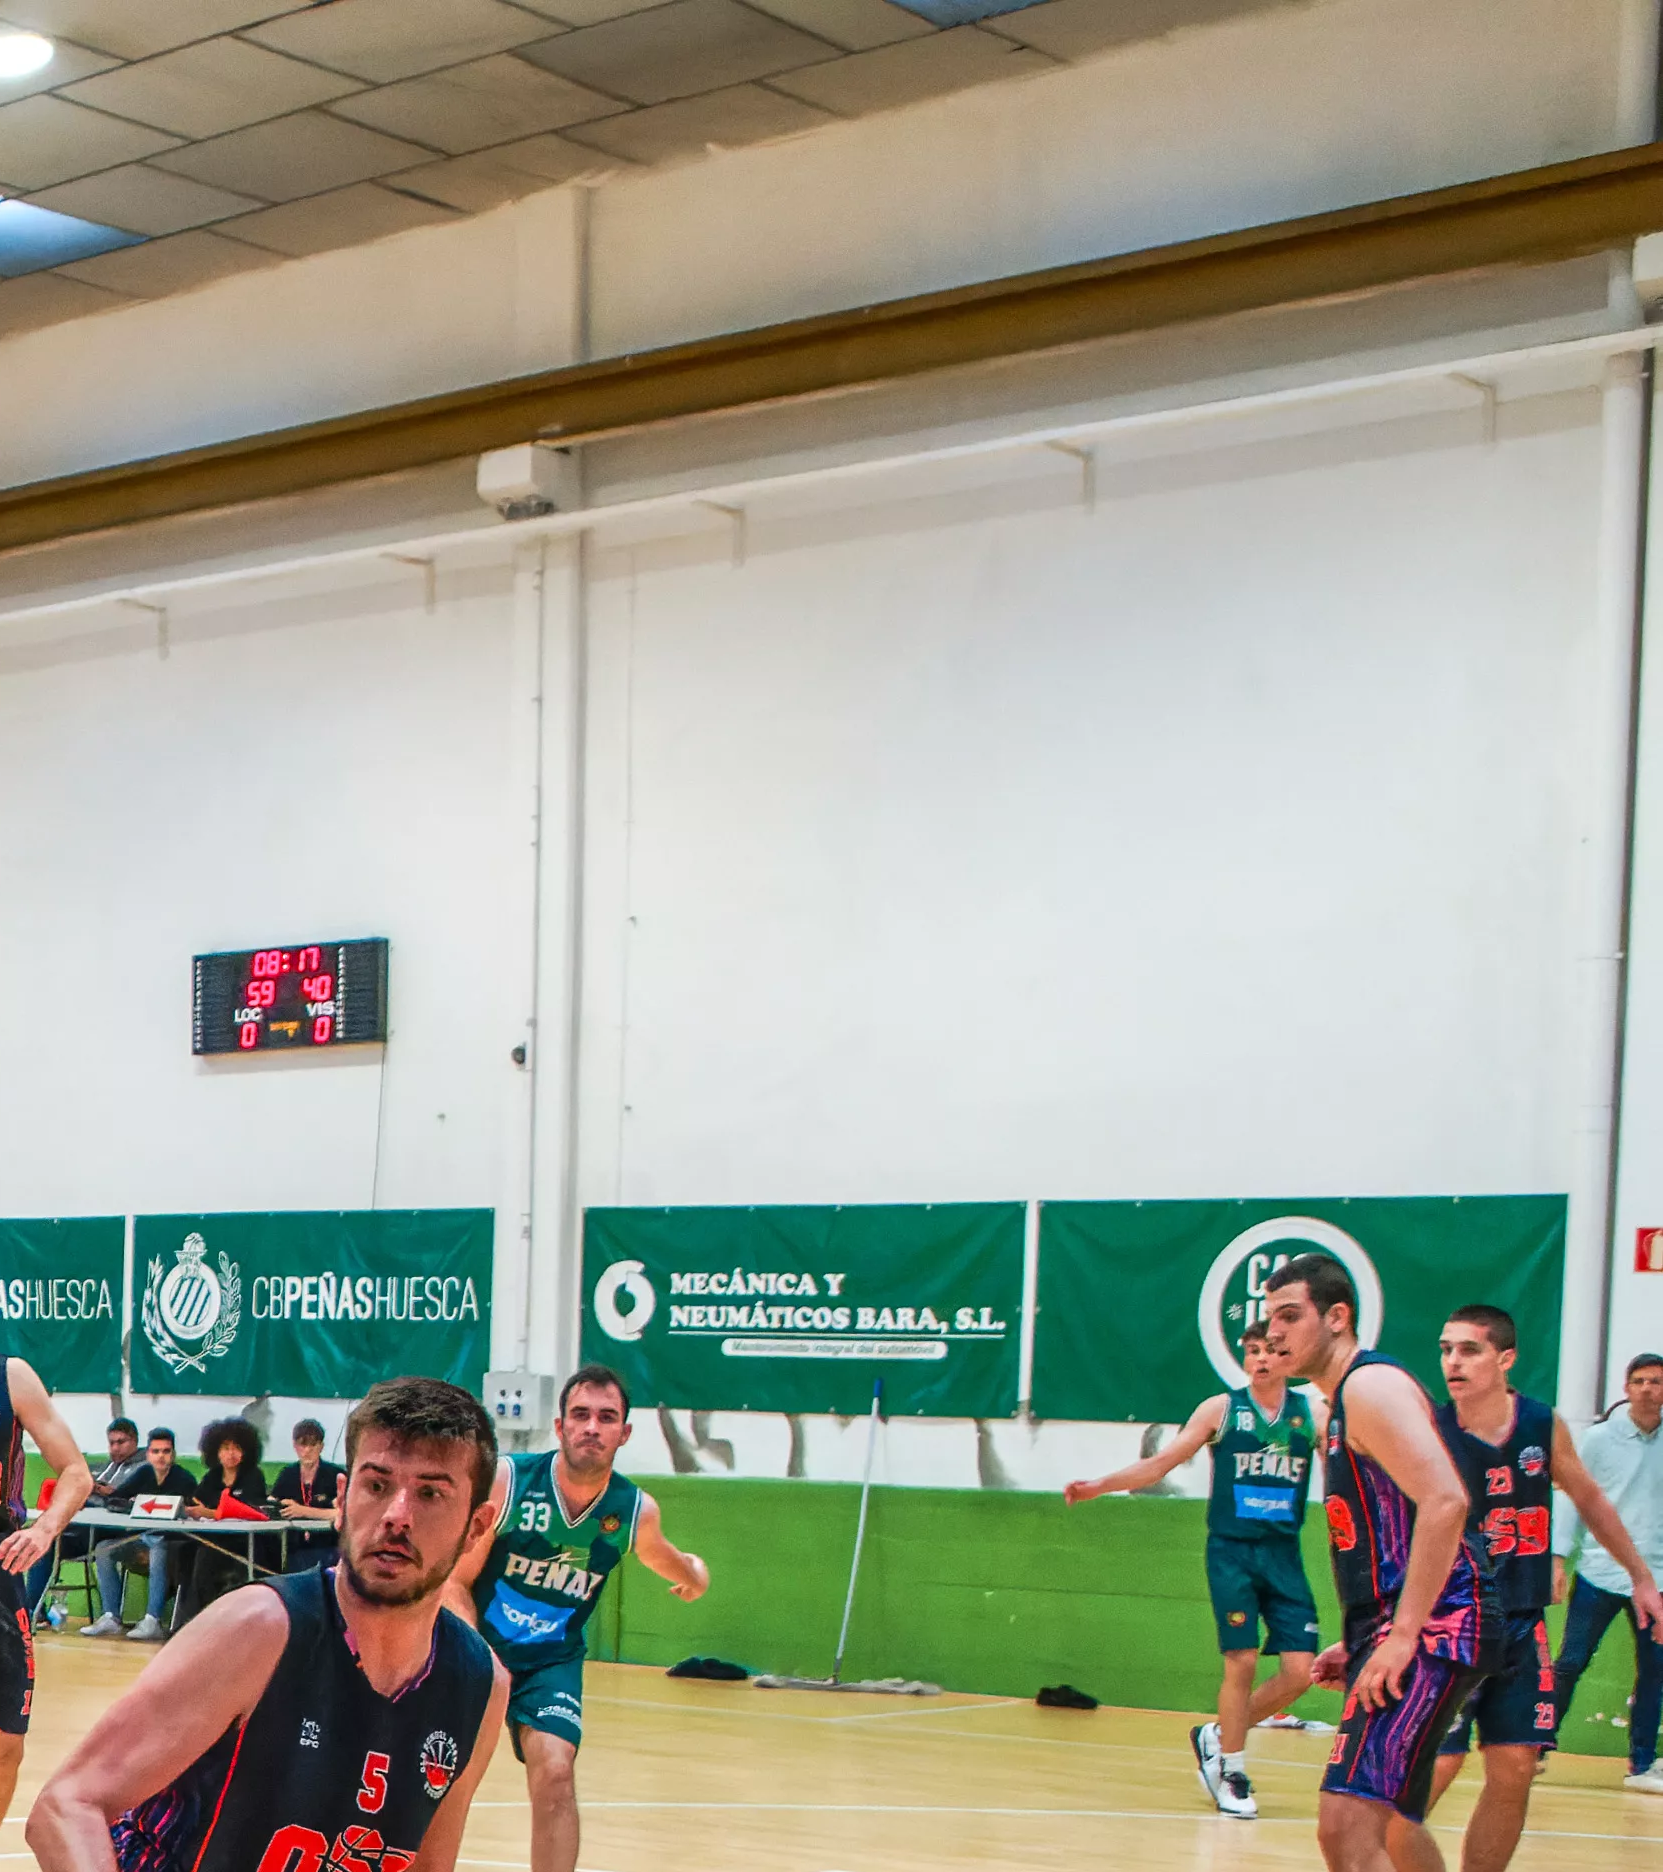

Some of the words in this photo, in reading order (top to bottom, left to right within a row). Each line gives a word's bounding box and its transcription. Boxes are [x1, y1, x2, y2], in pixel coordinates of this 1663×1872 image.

[251, 945, 322, 978] 08:17
[246, 979, 276, 1008] 59
[302, 975, 333, 1002] 40
[234, 1006, 263, 1023] LOC
[304, 1001, 337, 1018] VIS
[240, 1021, 259, 1049] 0
[313, 1015, 331, 1044] 0
[251, 1270, 480, 1322] CBPEÑASHUESCA
[669, 1267, 819, 1297] MECÁNICA
[824, 1273, 845, 1297] Y
[669, 1300, 851, 1331] NEUMÁTICOS
[855, 1306, 949, 1335] BARA,
[954, 1306, 1007, 1332] S.L.
[1236, 1411, 1255, 1432] 18
[1485, 1465, 1514, 1496] 23
[518, 1501, 552, 1532] 33
[355, 1750, 391, 1814] 5
